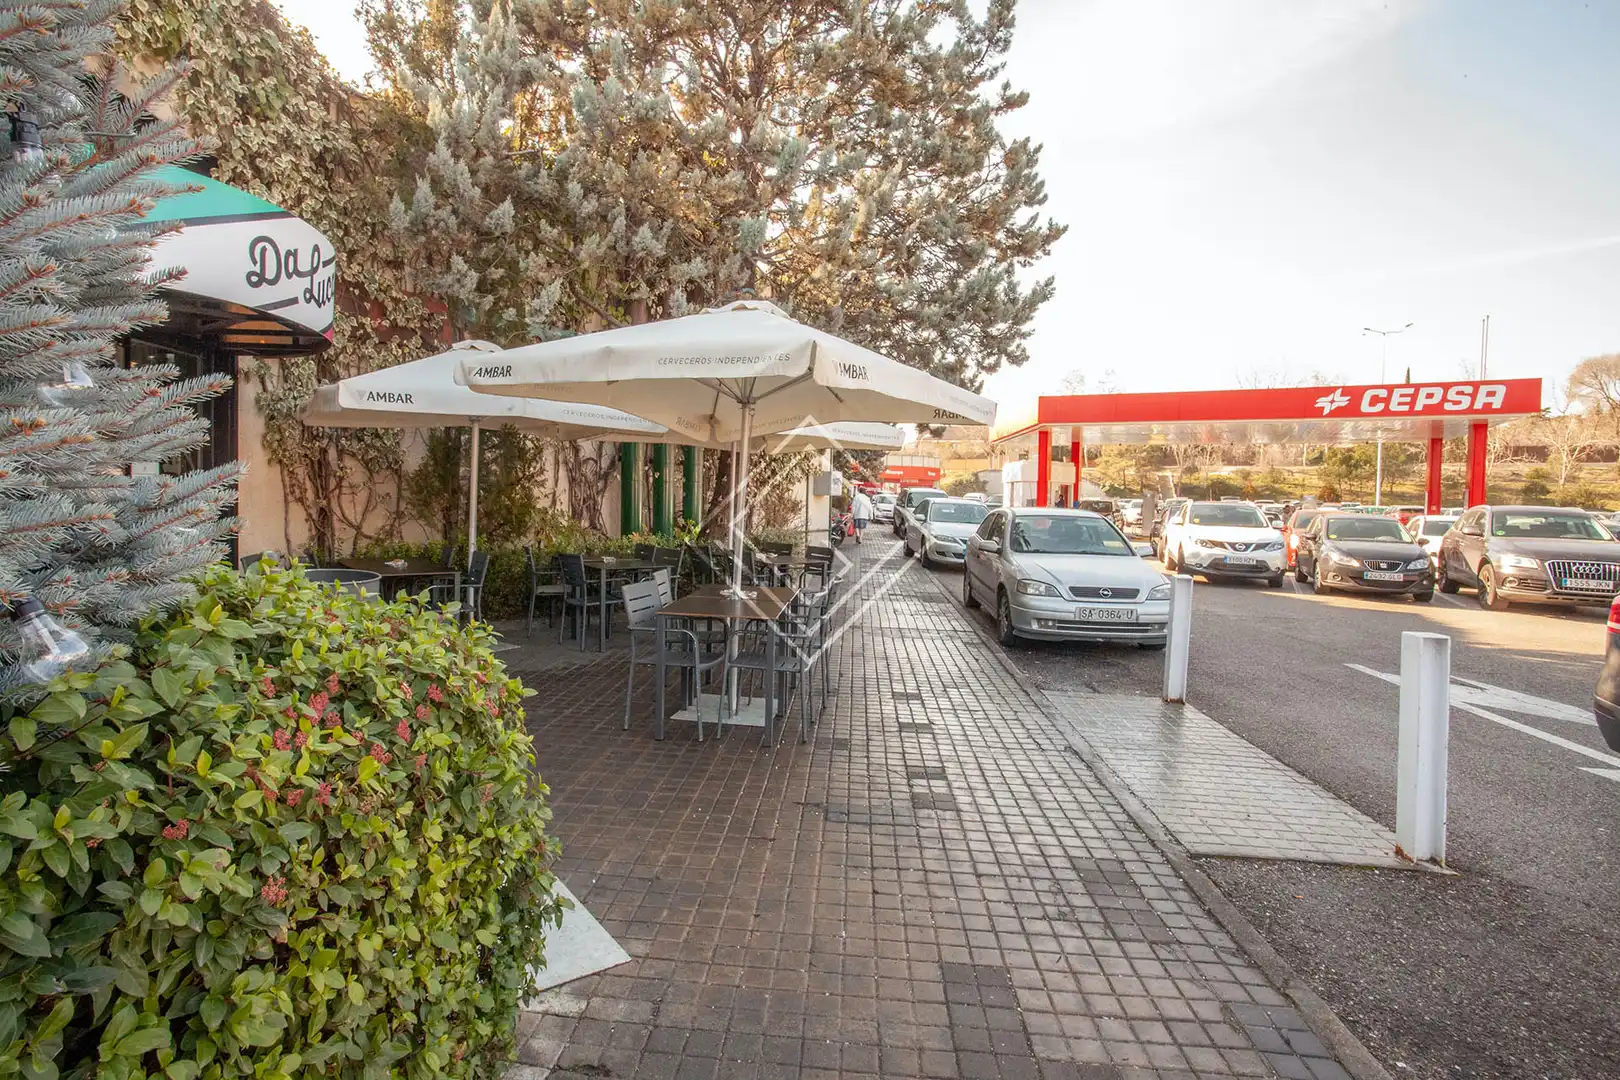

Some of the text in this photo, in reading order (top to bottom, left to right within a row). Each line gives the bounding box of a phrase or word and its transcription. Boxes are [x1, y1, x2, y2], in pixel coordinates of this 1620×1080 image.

[303, 244, 336, 308] Luc
[658, 357, 712, 366] CERVECEROS
[473, 365, 512, 378] AMBAR
[366, 391, 414, 405] AMBAR
[1360, 384, 1507, 413] CEPSA
